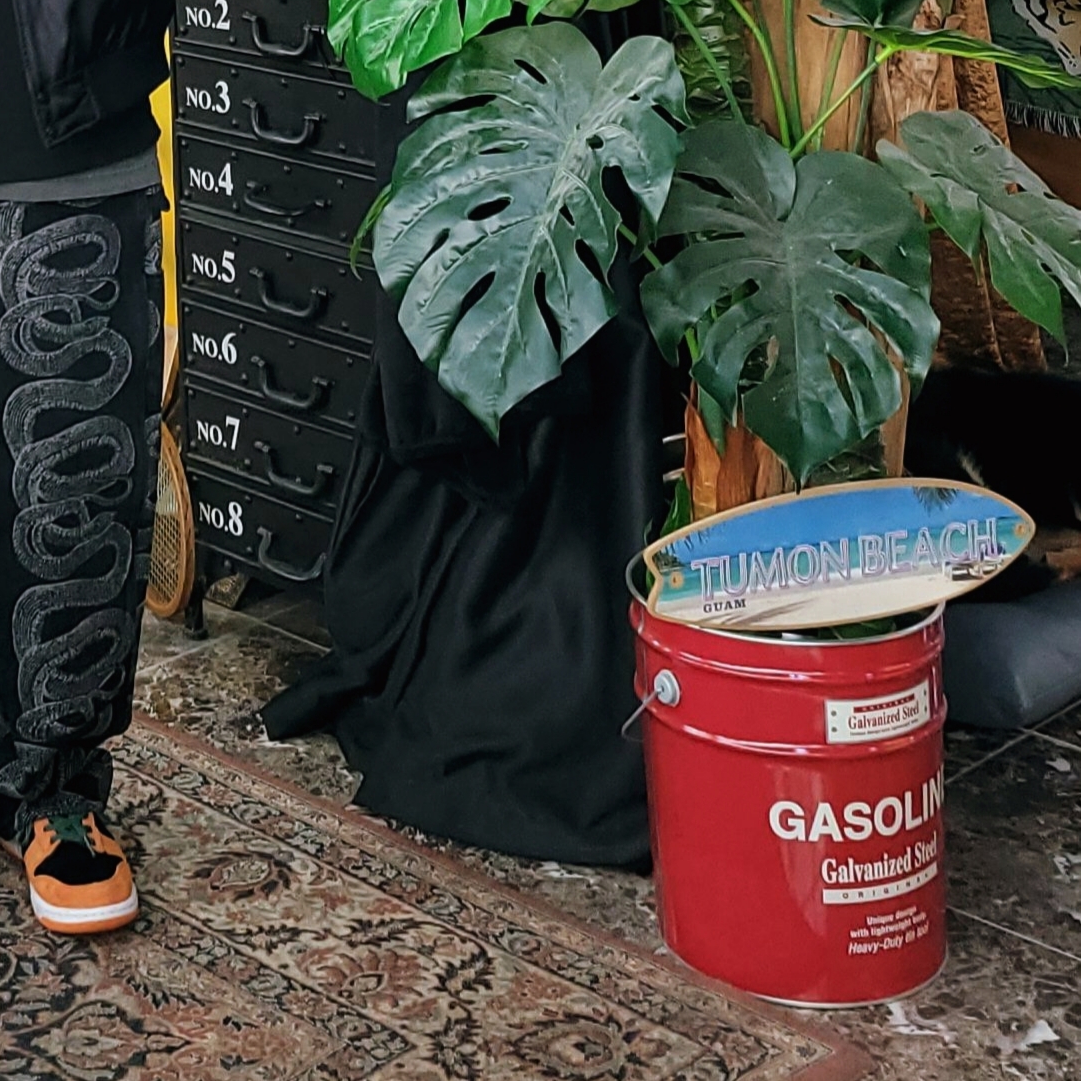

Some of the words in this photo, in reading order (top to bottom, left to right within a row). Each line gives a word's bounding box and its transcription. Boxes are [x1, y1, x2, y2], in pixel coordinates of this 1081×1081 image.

[690, 536, 850, 603] TUMON
[857, 517, 1000, 579] BEACH
[703, 598, 747, 614] GUAM
[848, 709, 901, 730] Galvanized
[902, 700, 920, 720] Steel
[769, 763, 945, 842] GASOLIN
[821, 846, 913, 885] Galvanized
[914, 830, 938, 868] Steel
